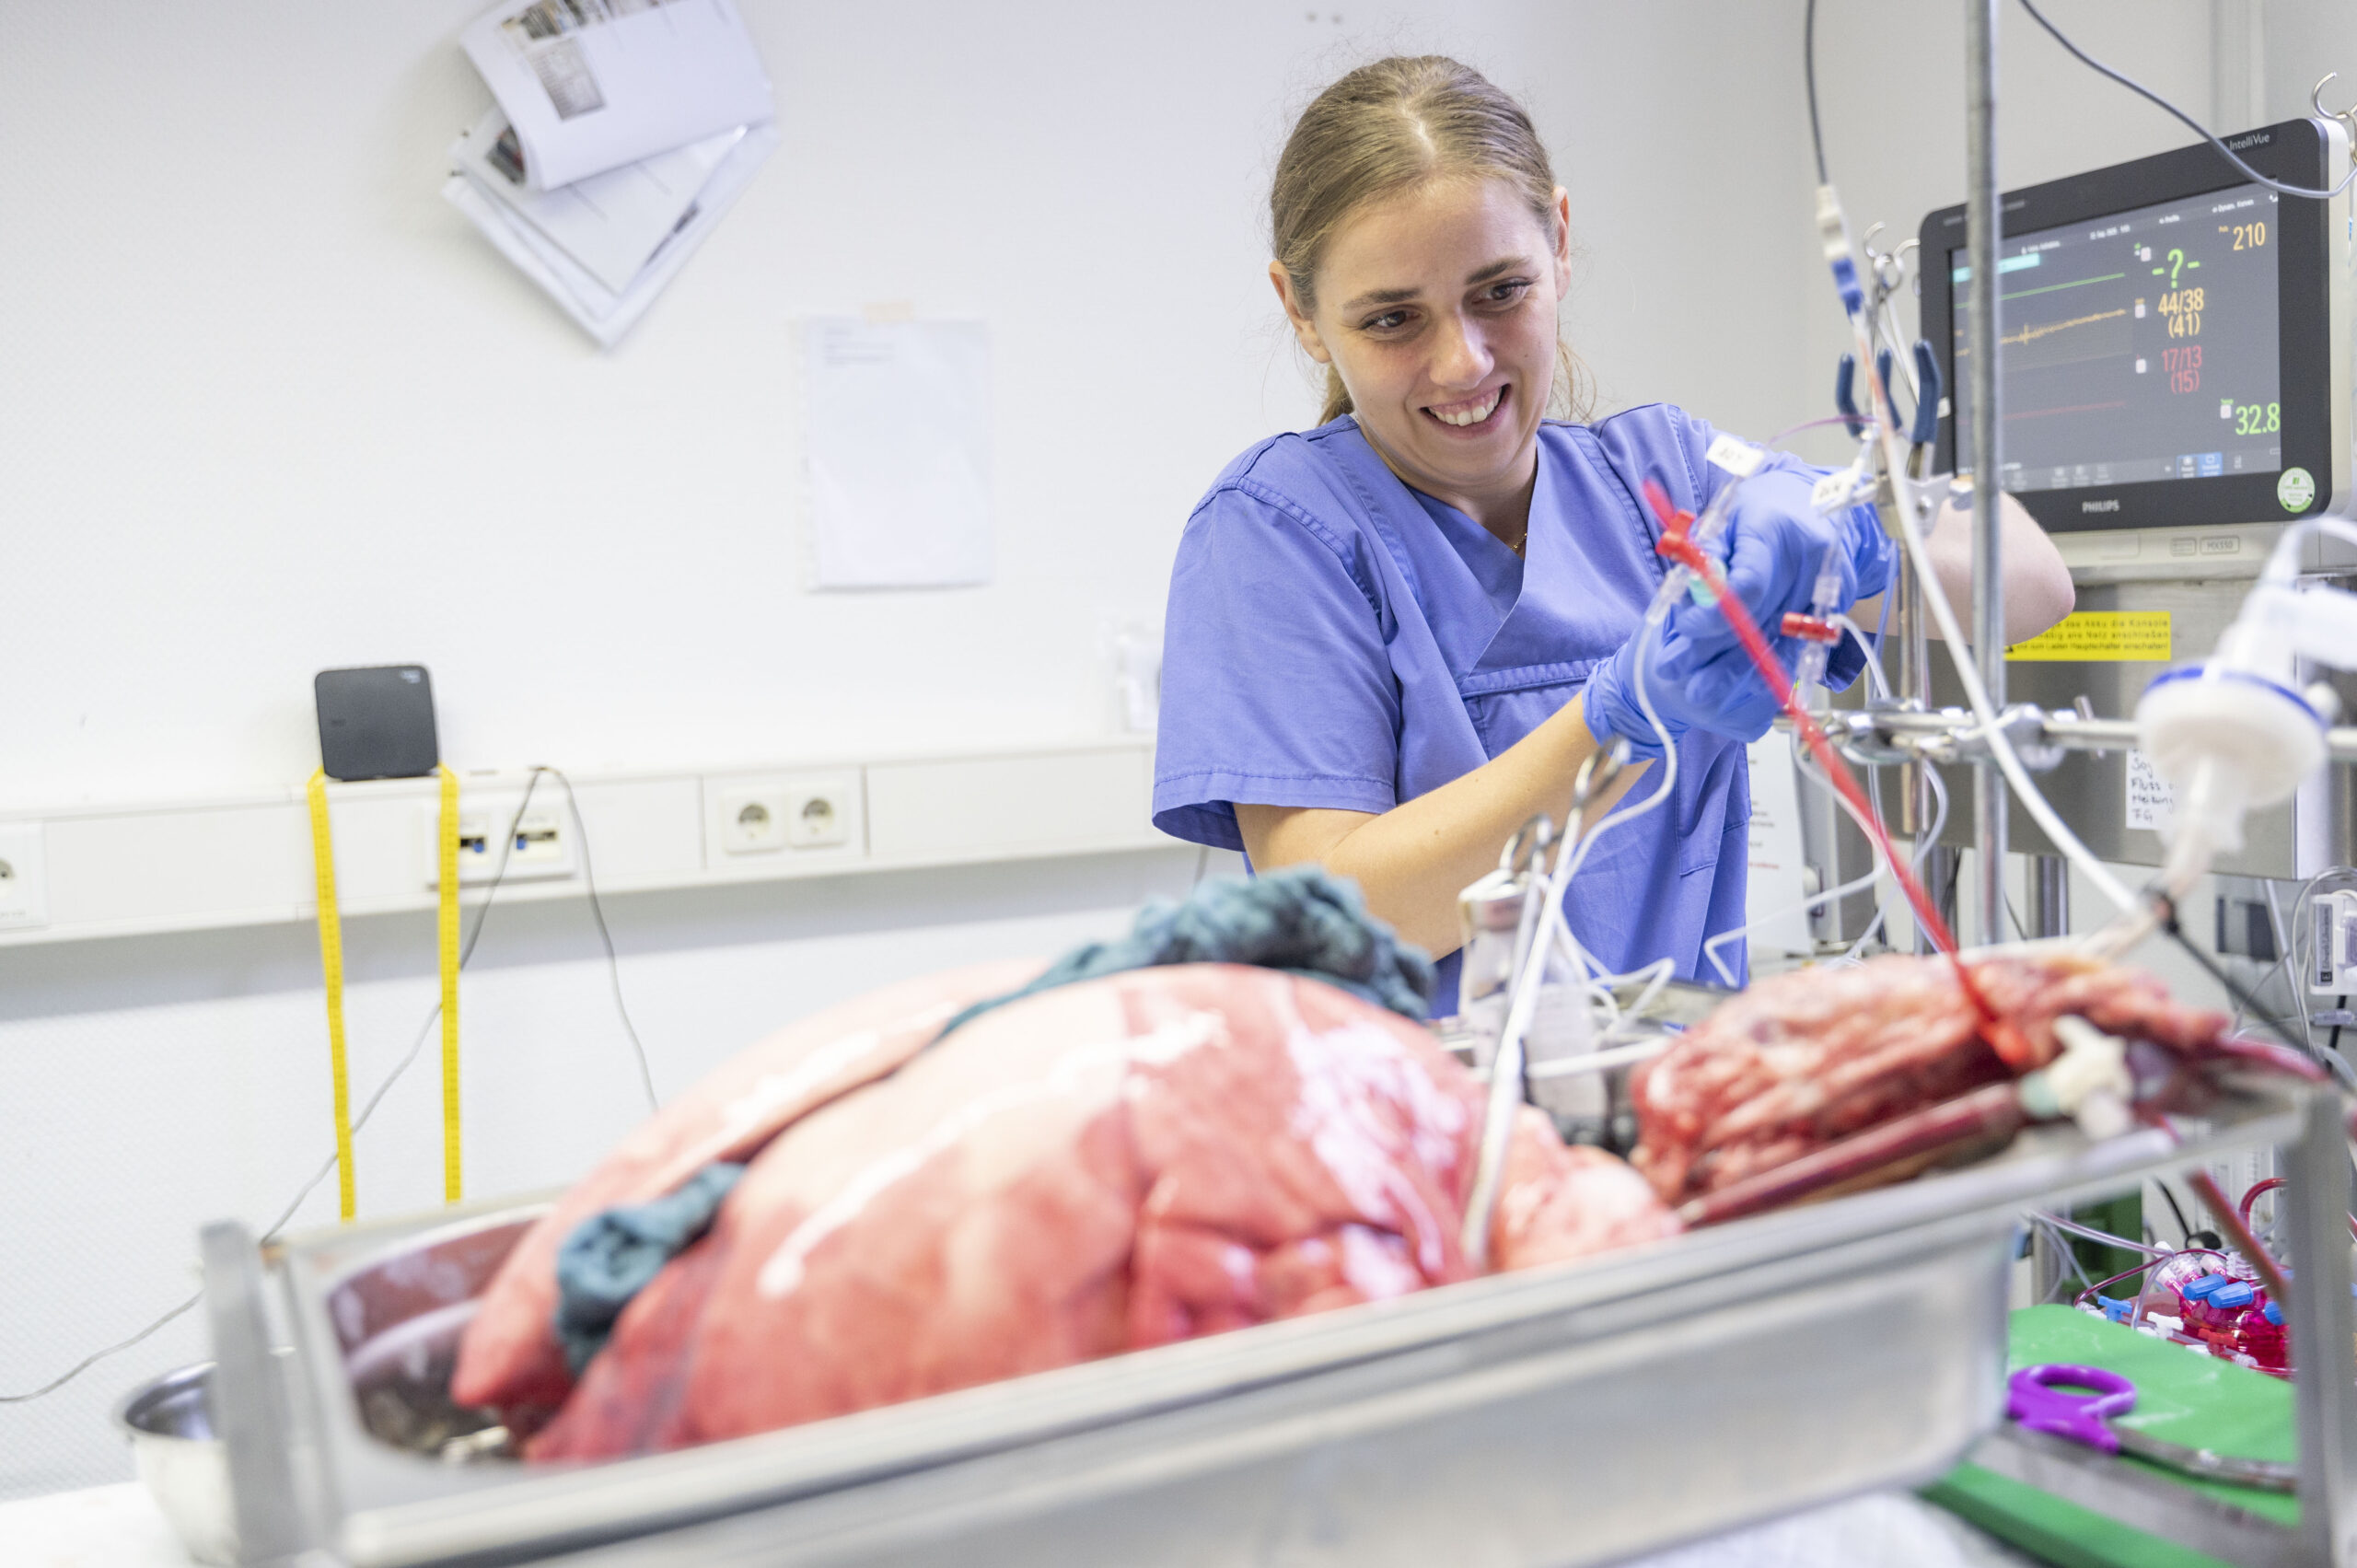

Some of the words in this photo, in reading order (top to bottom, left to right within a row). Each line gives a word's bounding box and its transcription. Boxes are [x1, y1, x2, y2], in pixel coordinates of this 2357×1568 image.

[2229, 133, 2270, 151] IntelliVue
[2233, 221, 2266, 251] 210
[2157, 287, 2205, 317] 44/38
[2167, 312, 2201, 339] (41)
[2161, 344, 2203, 372] 17/13
[2170, 369, 2200, 394] (15)
[2235, 402, 2282, 436] 32.8
[2082, 500, 2120, 514] PHILIPS
[2129, 618, 2168, 628] Konsole
